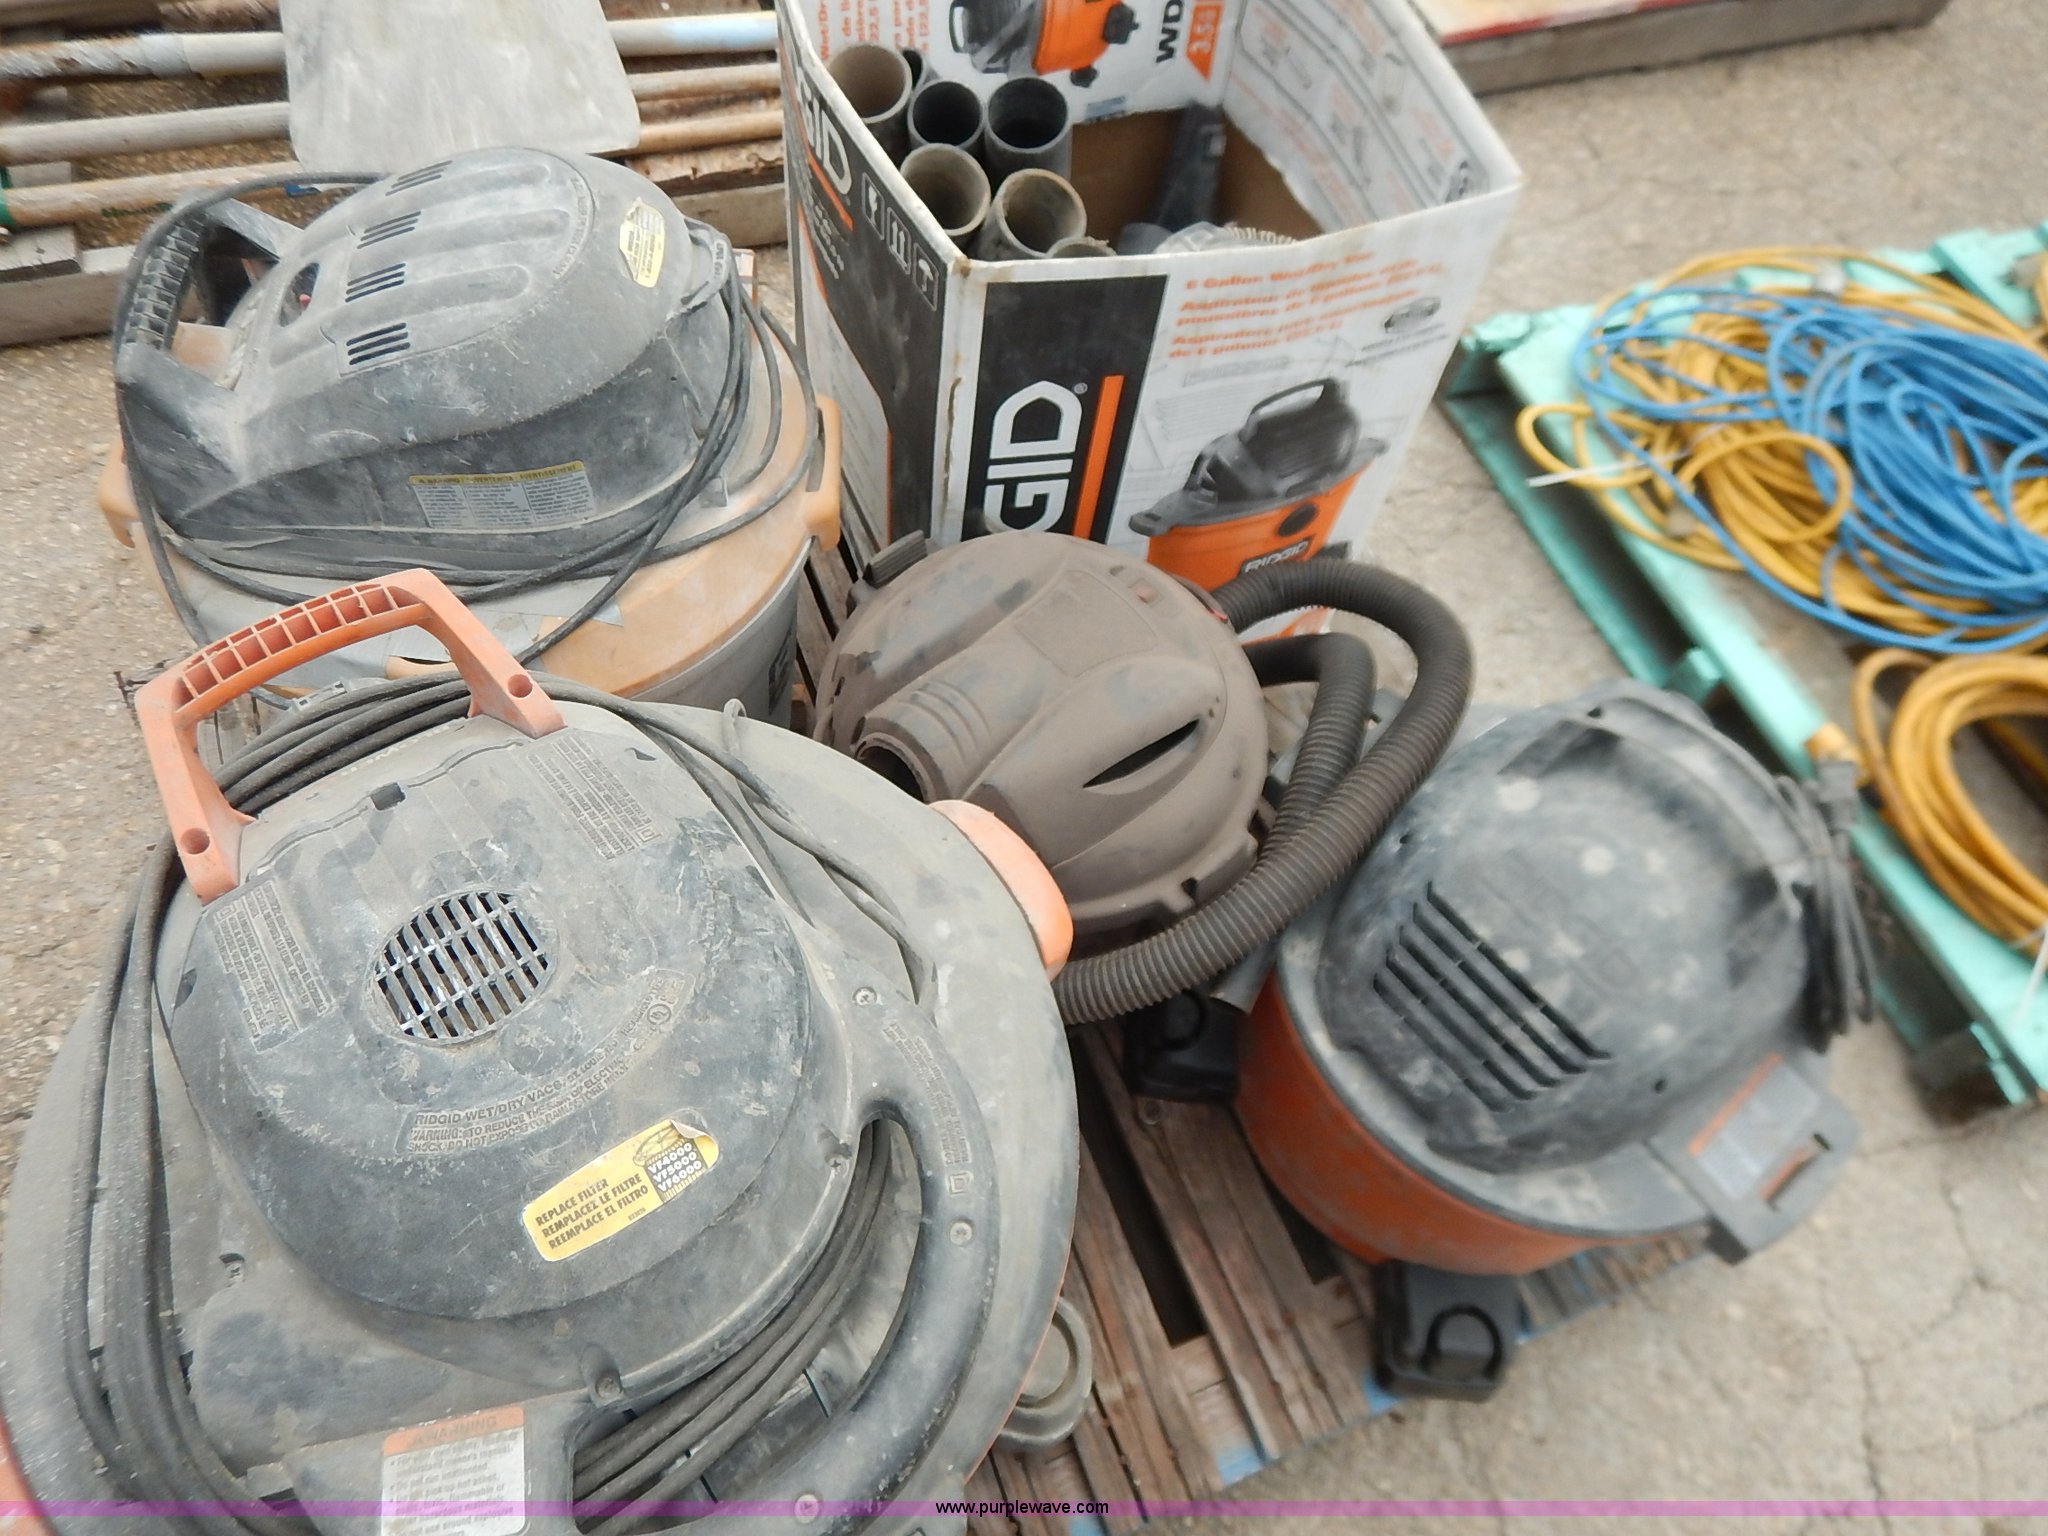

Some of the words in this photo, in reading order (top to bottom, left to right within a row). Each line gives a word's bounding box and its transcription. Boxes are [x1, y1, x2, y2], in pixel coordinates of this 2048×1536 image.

[414, 1112, 461, 1125] RIDGID
[465, 1096, 524, 1121] WET/DRY
[485, 1113, 526, 1133] REDUCE
[465, 1135, 487, 1148] NOT
[648, 1142, 692, 1174] VF4000
[653, 1151, 697, 1183] VF5000
[657, 1160, 702, 1192] VF6000
[535, 1196, 578, 1226] REPLACE
[577, 1178, 609, 1202] FILTER
[542, 1200, 599, 1238] REMPLACEZ
[599, 1192, 612, 1205] LE
[611, 1173, 642, 1197] FILTRE
[548, 1211, 604, 1249] REEMPLACE
[604, 1205, 617, 1217] EL
[617, 1184, 649, 1209] FILTRO
